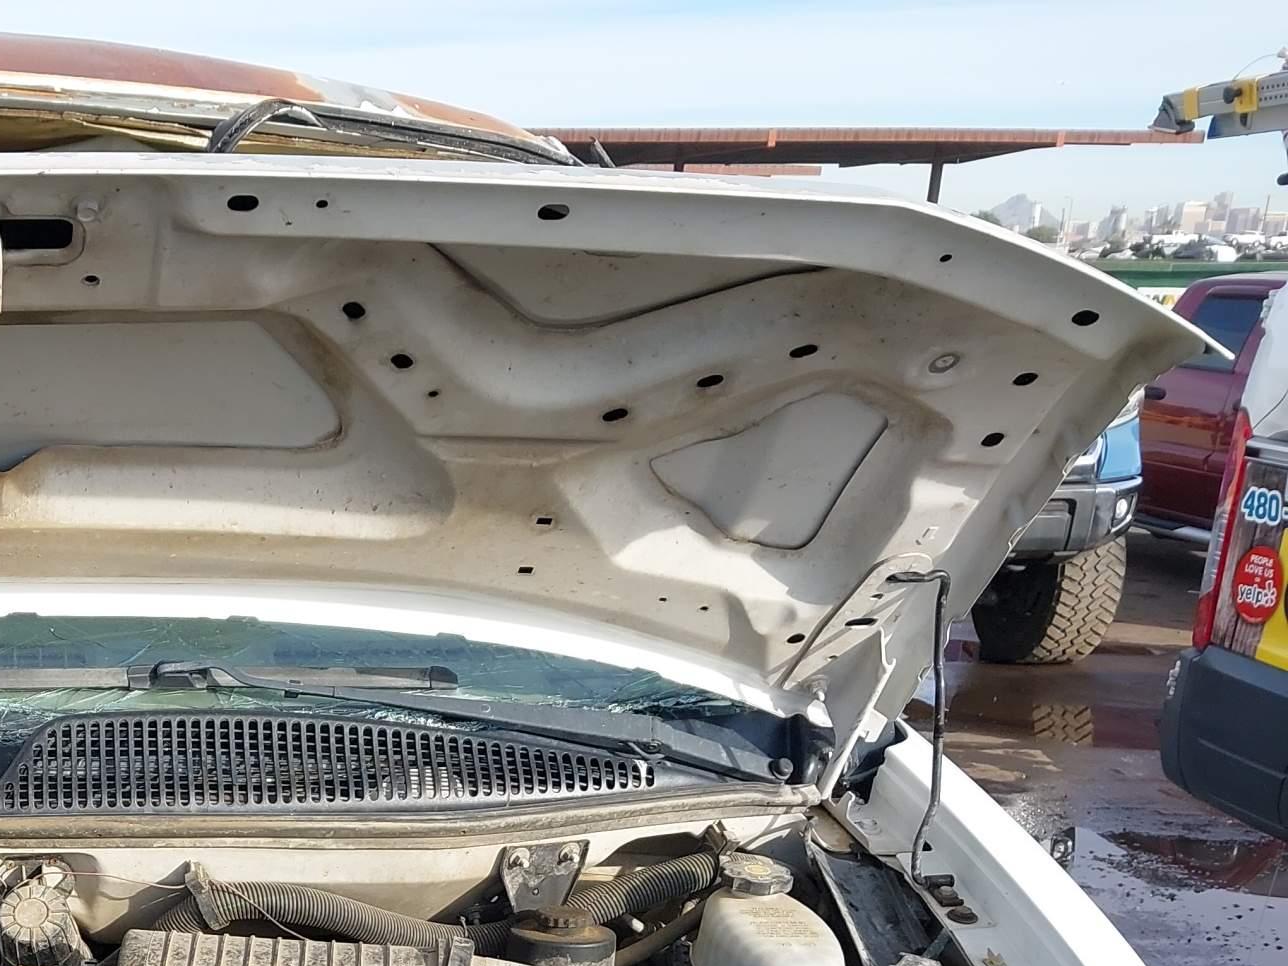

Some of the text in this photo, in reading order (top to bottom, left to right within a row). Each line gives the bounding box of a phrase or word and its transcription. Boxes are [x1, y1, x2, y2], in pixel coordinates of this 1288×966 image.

[1250, 554, 1274, 566] PEOPLE
[1245, 563, 1274, 578] LOVE US
[1238, 584, 1264, 607] yelp
